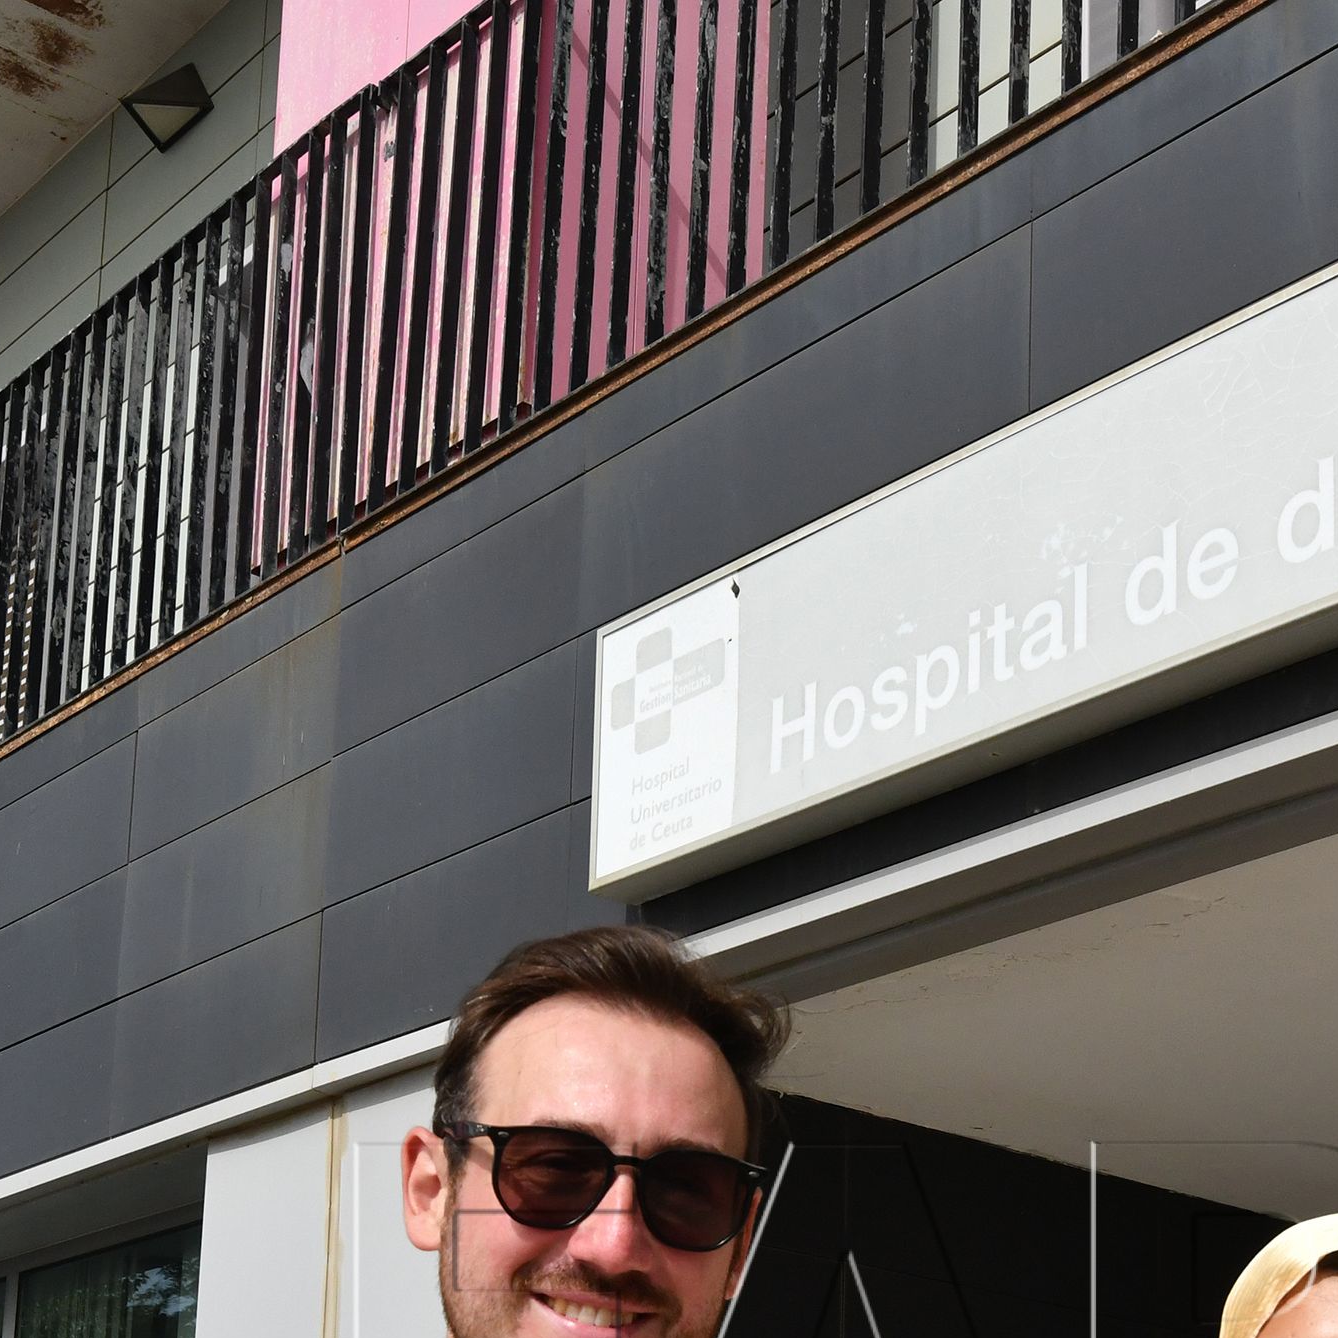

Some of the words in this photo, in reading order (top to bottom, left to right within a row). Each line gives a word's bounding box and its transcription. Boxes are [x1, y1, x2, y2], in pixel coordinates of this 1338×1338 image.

[768, 562, 1089, 774] Hospital
[1124, 518, 1240, 628] de
[631, 756, 691, 797] Hospital
[629, 776, 723, 825] Universitario
[628, 831, 646, 852] de
[650, 814, 694, 843] Ceuta
